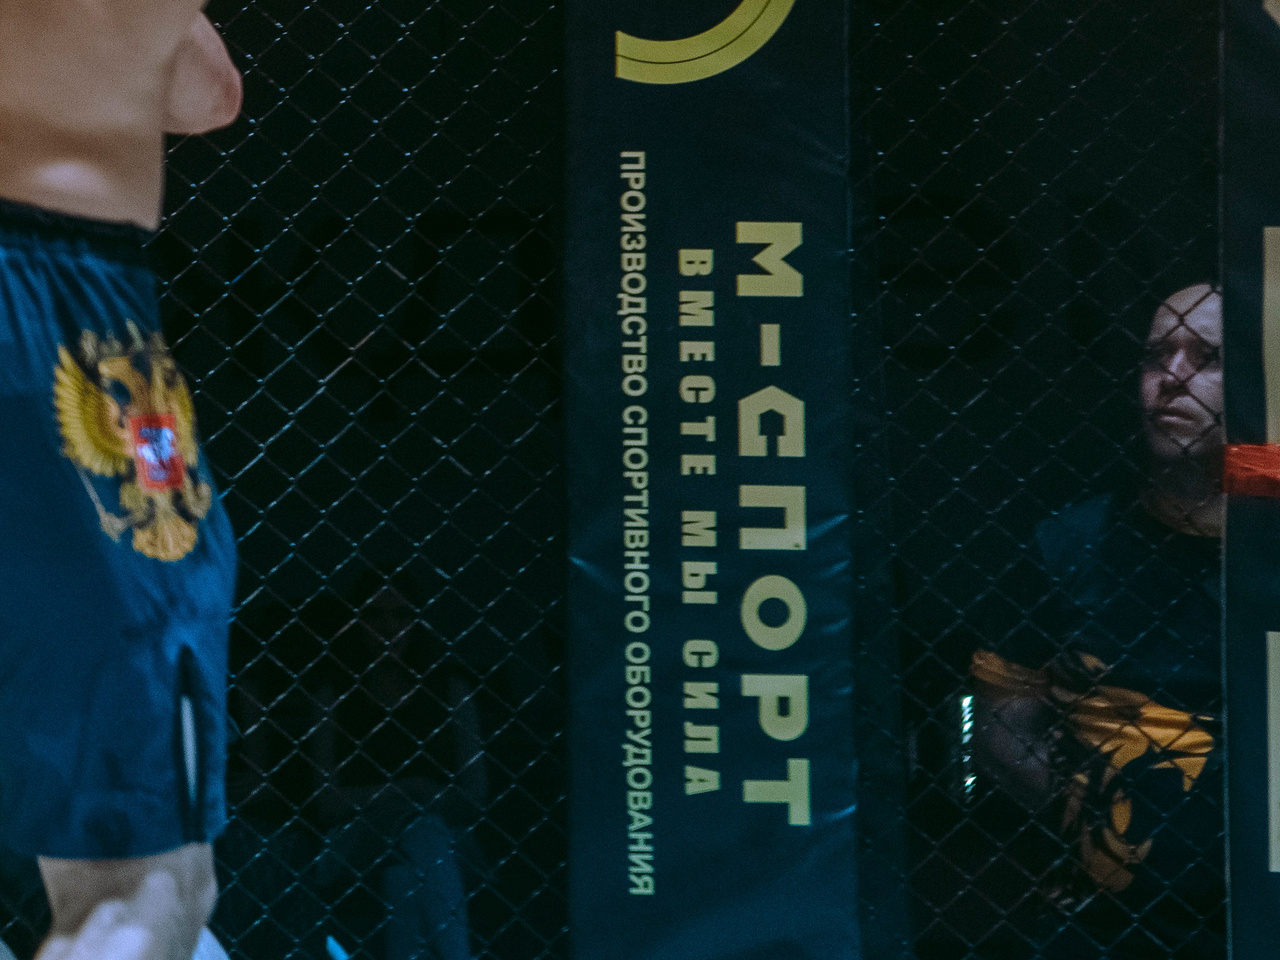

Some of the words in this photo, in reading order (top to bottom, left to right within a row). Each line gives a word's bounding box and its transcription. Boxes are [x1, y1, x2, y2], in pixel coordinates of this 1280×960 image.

[617, 150, 648, 397] ПРОИЗВОДСТВО
[678, 248, 717, 476] ВМЕСТЕ
[622, 405, 651, 633] СПОРТИВНОГО
[681, 510, 718, 604] МЫ
[736, 221, 812, 826] М-СПОРТ
[621, 641, 656, 895] ОБОРУДОВАНИЯ
[682, 639, 721, 796] СИЛА
